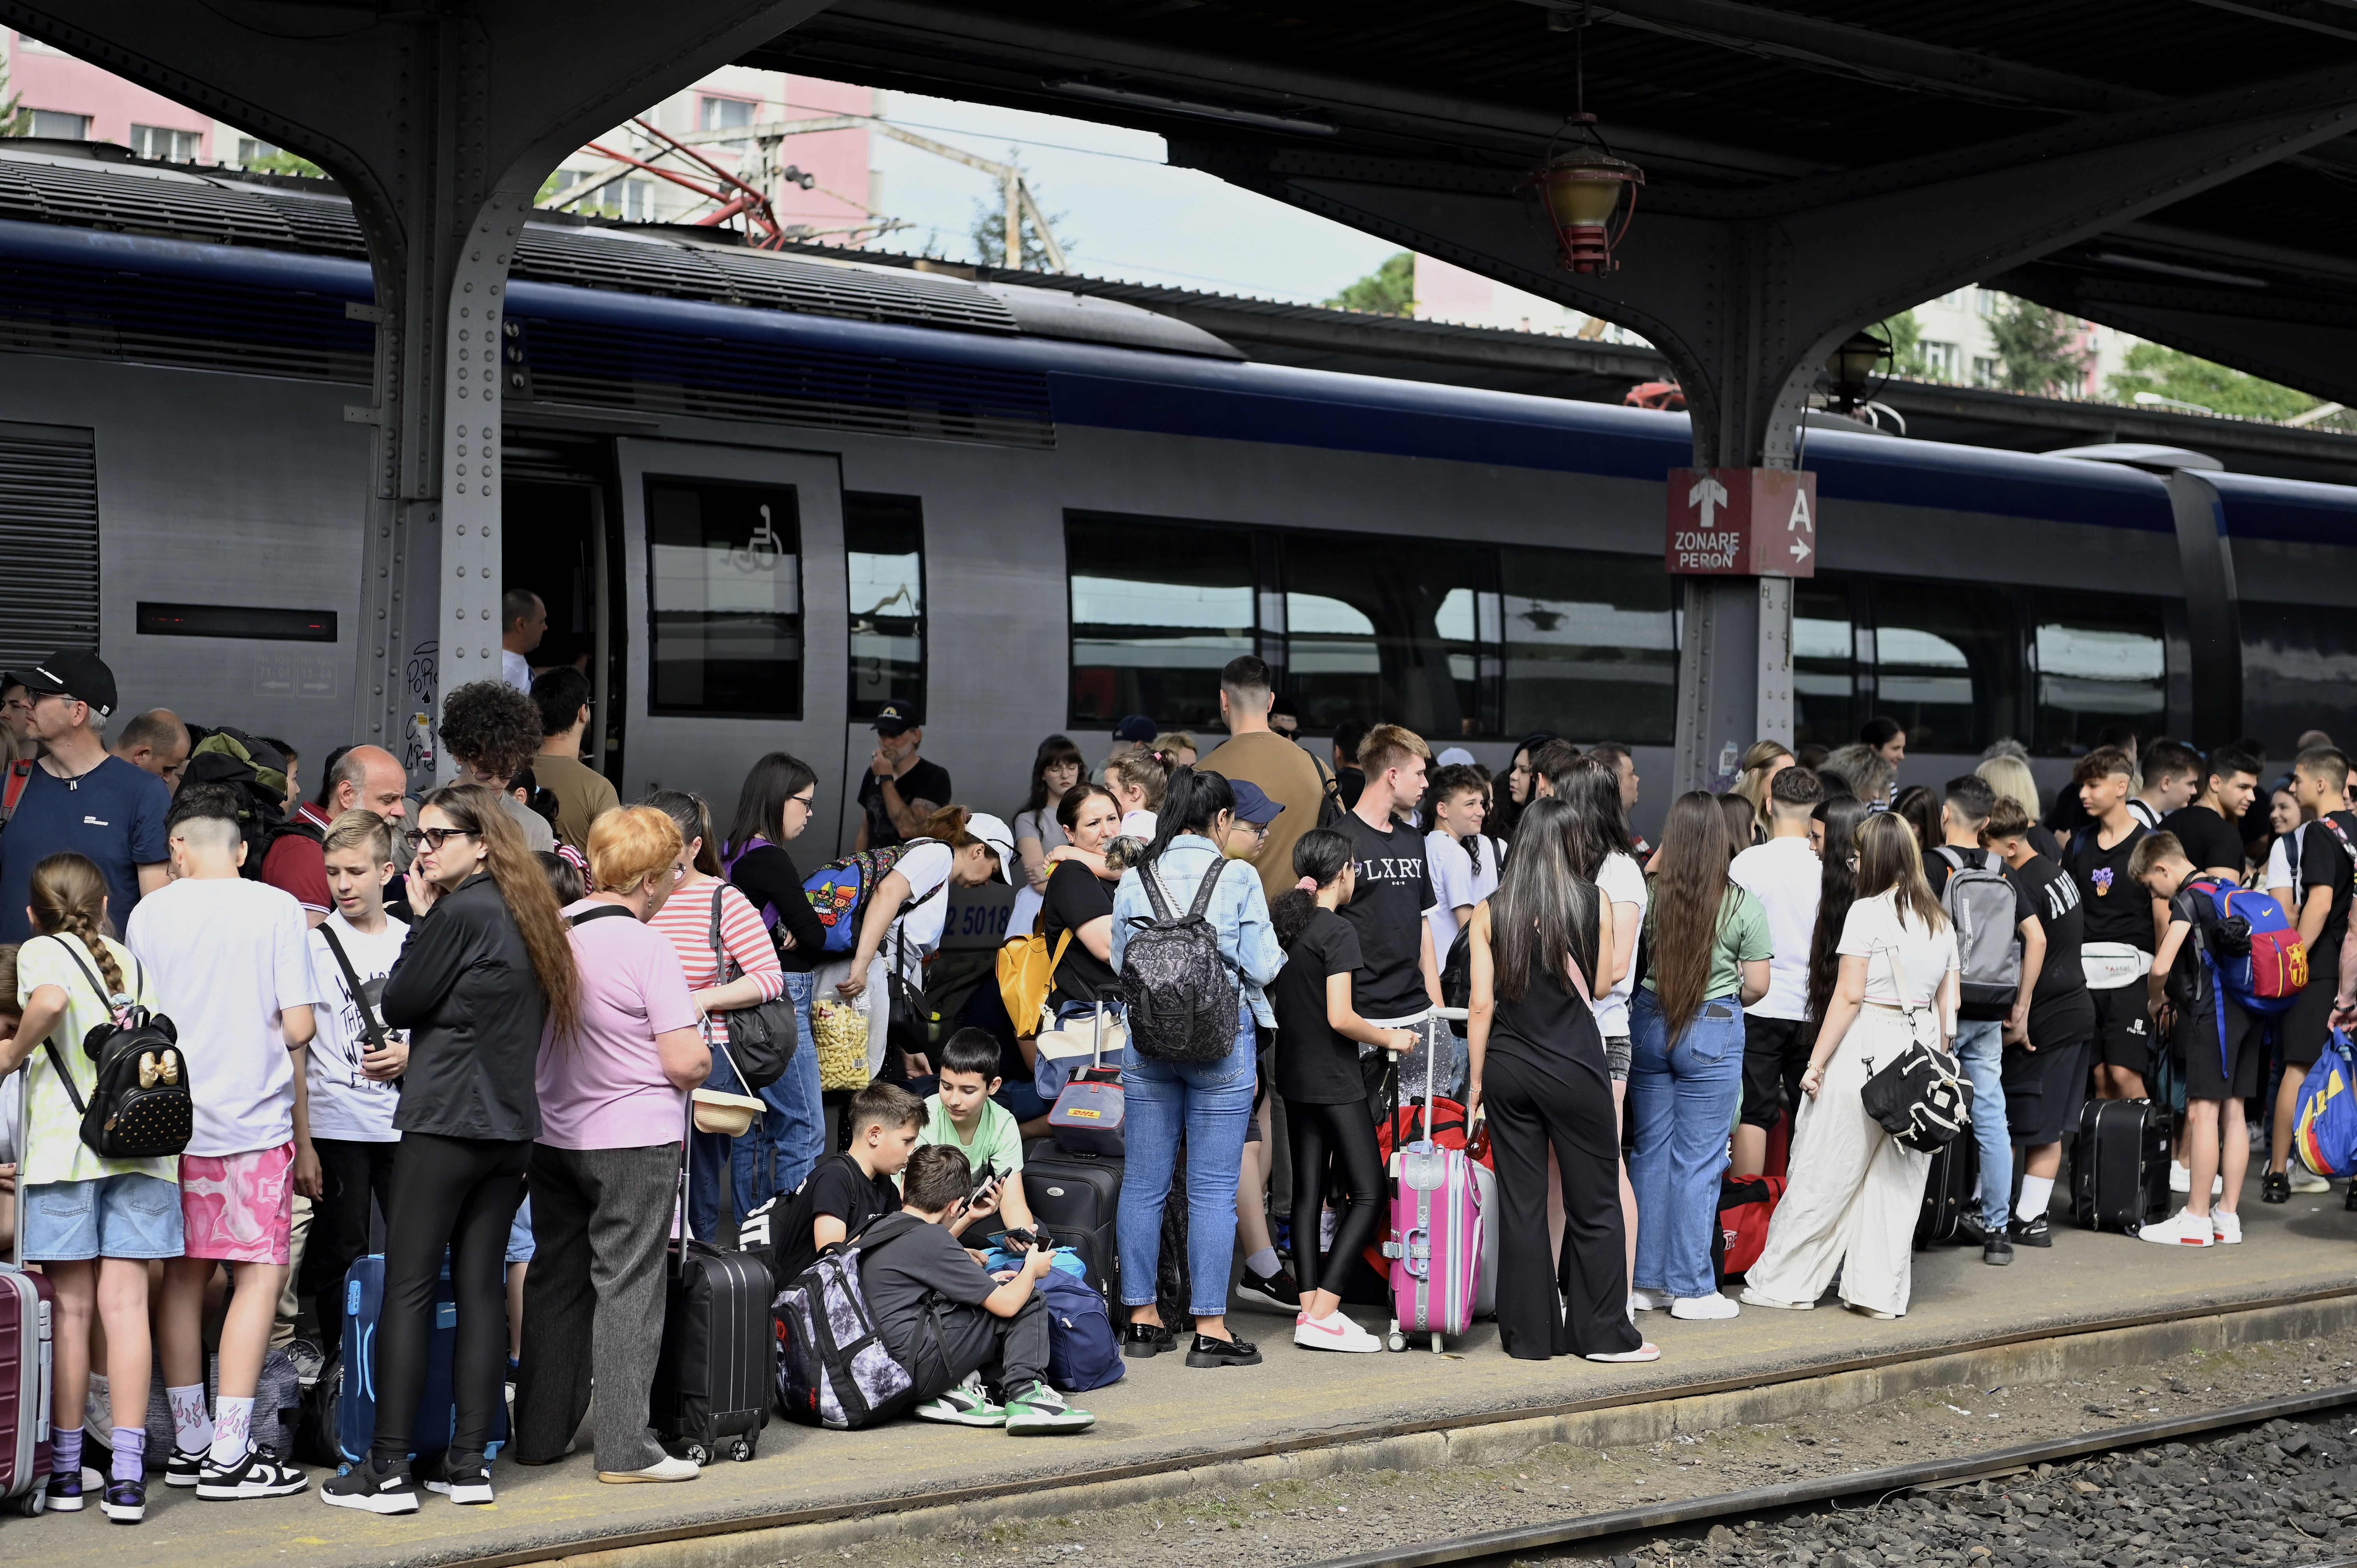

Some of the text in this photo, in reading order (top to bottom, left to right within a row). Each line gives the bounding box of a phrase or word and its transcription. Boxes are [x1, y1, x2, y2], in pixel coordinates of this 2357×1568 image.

[1788, 489, 1812, 533] A
[1675, 531, 1739, 551] ZONARE
[1680, 553, 1733, 568] PERON
[1364, 858, 1422, 880] LXRY
[963, 906, 1009, 935] 5018
[1417, 1305, 1426, 1331] BXXJ
[1025, 1391, 1039, 1401] PUMA
